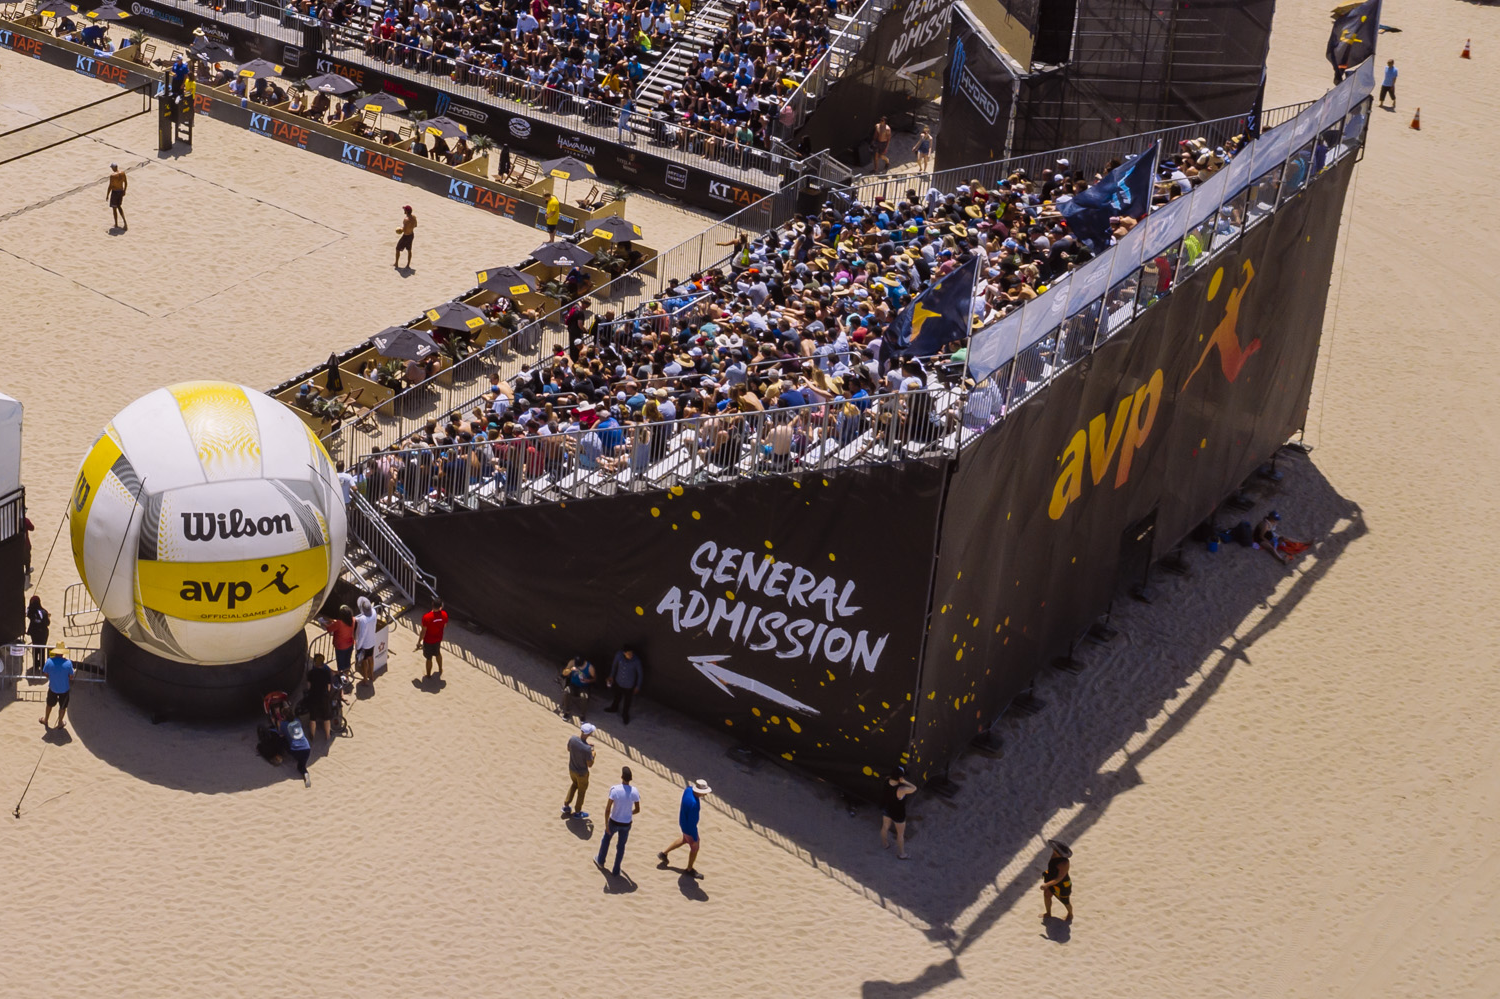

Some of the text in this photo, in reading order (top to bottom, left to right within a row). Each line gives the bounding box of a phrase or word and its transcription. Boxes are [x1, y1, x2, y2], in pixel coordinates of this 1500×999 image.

[12, 31, 43, 55] TAPE
[76, 55, 128, 85] KT TAPE
[316, 57, 333, 73] KT
[333, 63, 365, 84] TAPE
[961, 71, 996, 118] HYDRO
[250, 112, 311, 146] KT TAPE
[450, 104, 485, 121] HYDRO
[341, 143, 406, 177] KT TAPE
[449, 179, 519, 215] KT TAPE
[709, 180, 730, 198] KT
[1048, 368, 1164, 521] avp
[181, 509, 294, 542] Wilson
[179, 579, 253, 610] avp
[690, 541, 863, 621] GENERAL
[242, 610, 266, 618] GAME
[267, 605, 288, 615] BALL
[656, 586, 890, 677] ADMISSION
